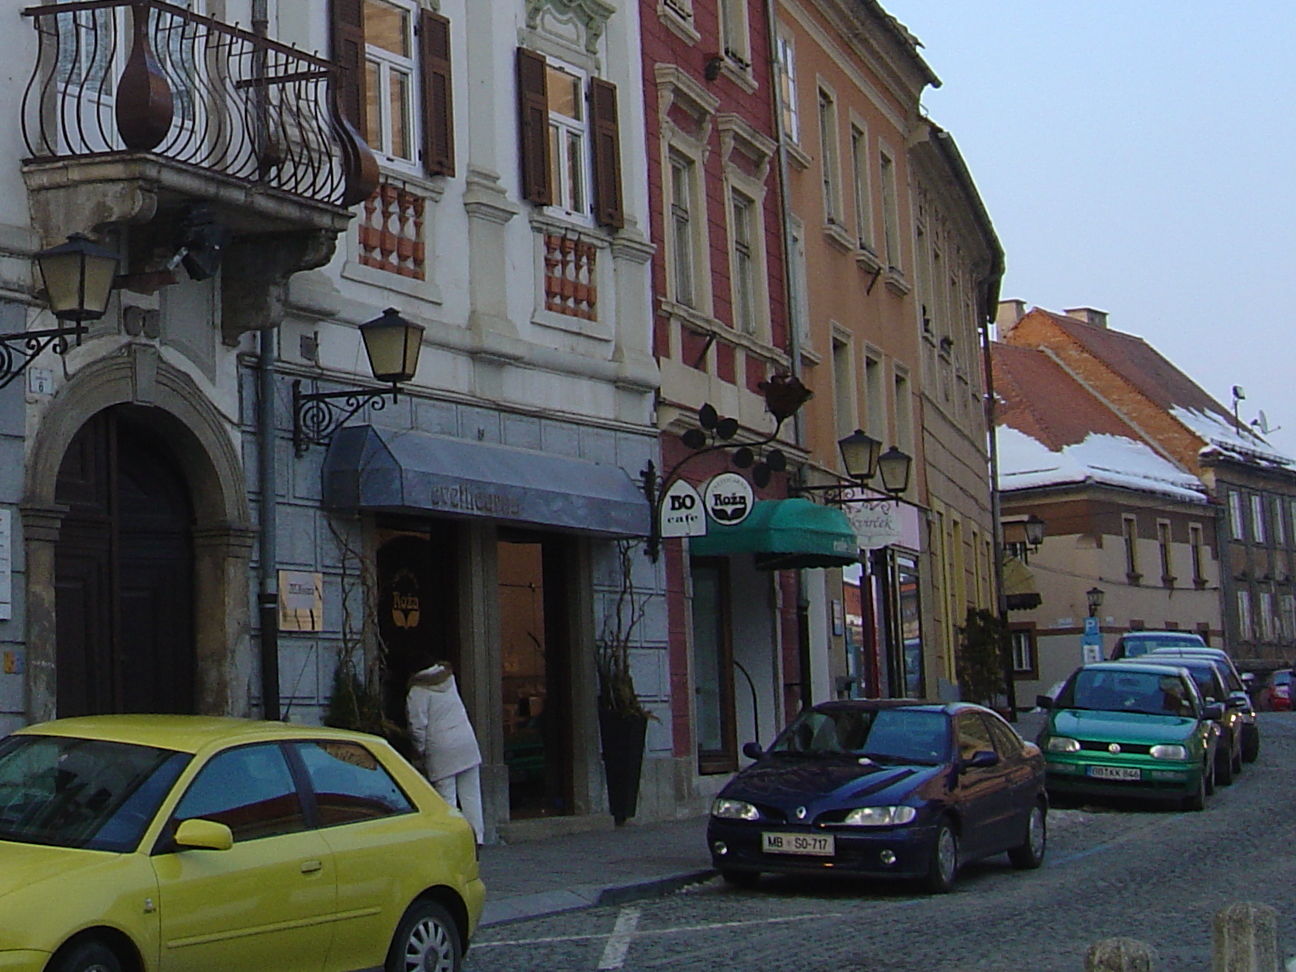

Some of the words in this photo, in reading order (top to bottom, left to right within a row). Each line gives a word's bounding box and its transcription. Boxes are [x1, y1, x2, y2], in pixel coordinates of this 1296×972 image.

[38, 381, 44, 393] 6
[669, 494, 695, 510] BO
[713, 493, 747, 507] Roža
[1085, 619, 1096, 632] P
[768, 836, 783, 848] MB
